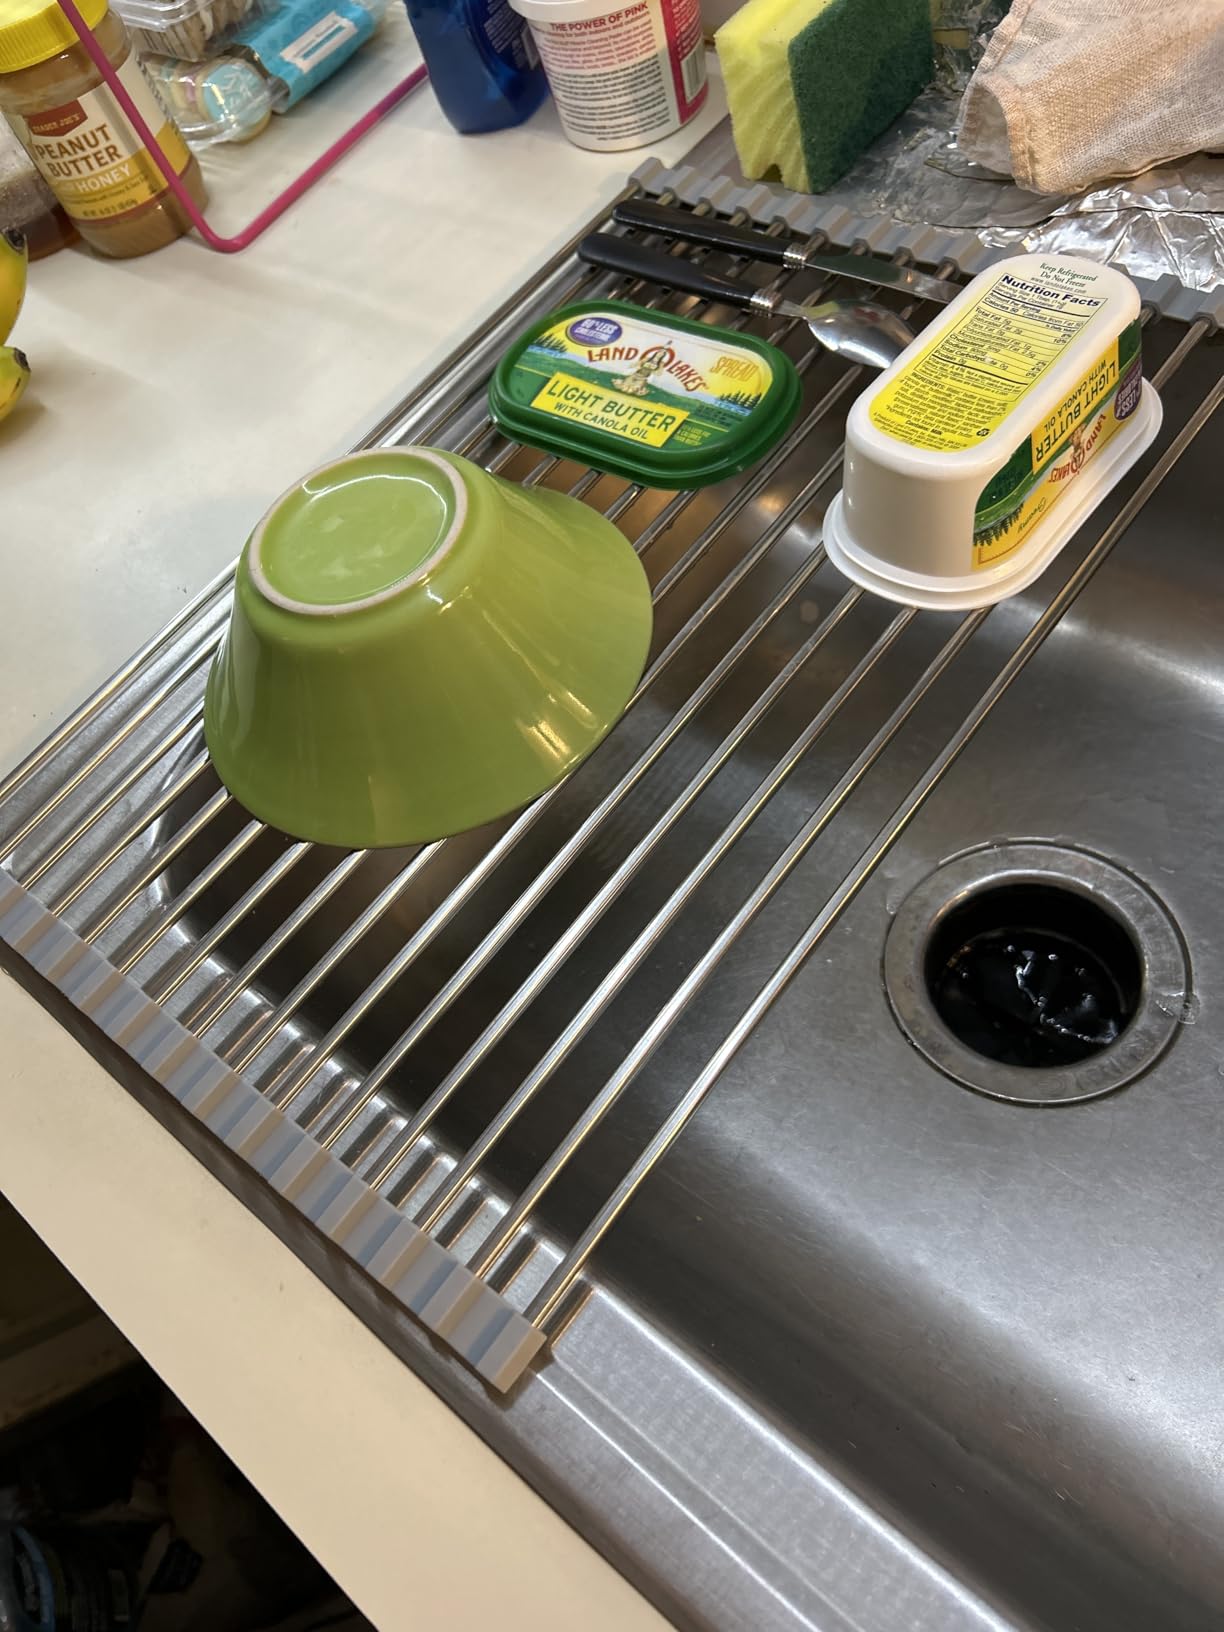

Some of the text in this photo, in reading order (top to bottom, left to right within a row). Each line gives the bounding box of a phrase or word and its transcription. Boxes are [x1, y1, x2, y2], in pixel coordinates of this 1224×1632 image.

[550, 0, 648, 31] THE POWER OF PINK
[35, 123, 113, 160] PEANUT
[48, 144, 124, 177] BUTTER
[77, 163, 132, 193] HONEY
[1040, 263, 1098, 282] Keep Refrigerated
[1040, 271, 1086, 288] Do Not Freeze
[1002, 275, 1101, 307] Nutrition Facts
[974, 307, 991, 317] Total
[983, 297, 1010, 309] Calories
[1022, 311, 1047, 320] Calories
[988, 292, 1010, 303] Amount
[1019, 303, 1041, 313] Serving
[1027, 298, 1055, 307] Container
[972, 315, 1002, 327] Saturated
[949, 333, 985, 348] Cholesterol
[957, 330, 1009, 348] Monounsaturated
[963, 325, 1010, 342] Polyunsaturated
[933, 349, 957, 360] Protein
[939, 344, 956, 353] Total
[955, 349, 997, 366] Carbohydte
[943, 339, 968, 350] Sodium
[587, 347, 639, 363] LAND
[667, 360, 706, 392] LAKES
[710, 356, 759, 382] SPREAD
[910, 372, 946, 389] INGREDIENTS:
[546, 379, 604, 411] LIGHT
[602, 398, 679, 433] BUTTER
[1043, 360, 1106, 433] WITH CANOLA OIL
[553, 402, 650, 440] WITH CANOLA OIL
[1035, 361, 1116, 463] LIGHT BUTTER
[904, 419, 931, 431] Contains:
[1086, 414, 1107, 451] LAND
[1047, 464, 1070, 483] LAKES
